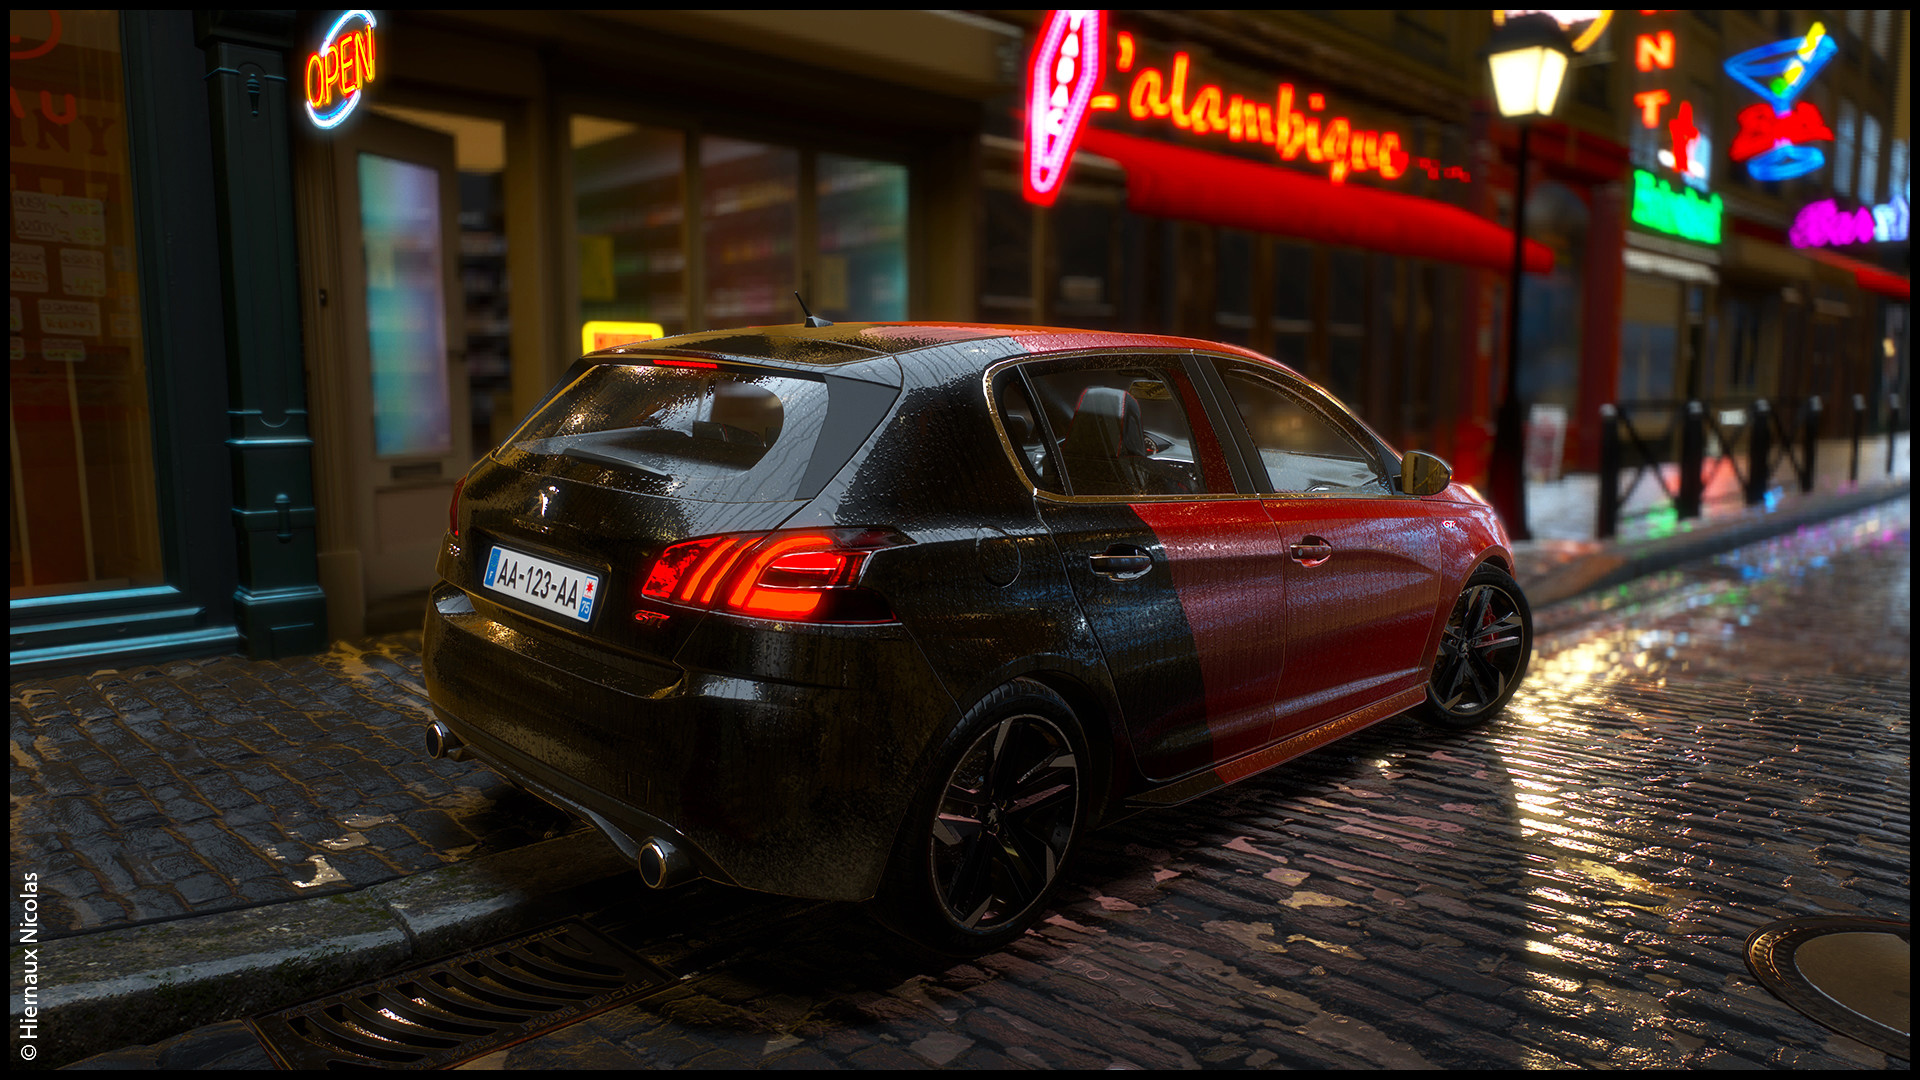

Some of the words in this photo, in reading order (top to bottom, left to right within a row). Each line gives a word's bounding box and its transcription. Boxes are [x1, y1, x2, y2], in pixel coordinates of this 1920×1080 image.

[305, 24, 375, 109] OPEN
[1091, 31, 1409, 184] 'alambique
[497, 558, 578, 610] AA-123-AA
[581, 600, 591, 614] 75
